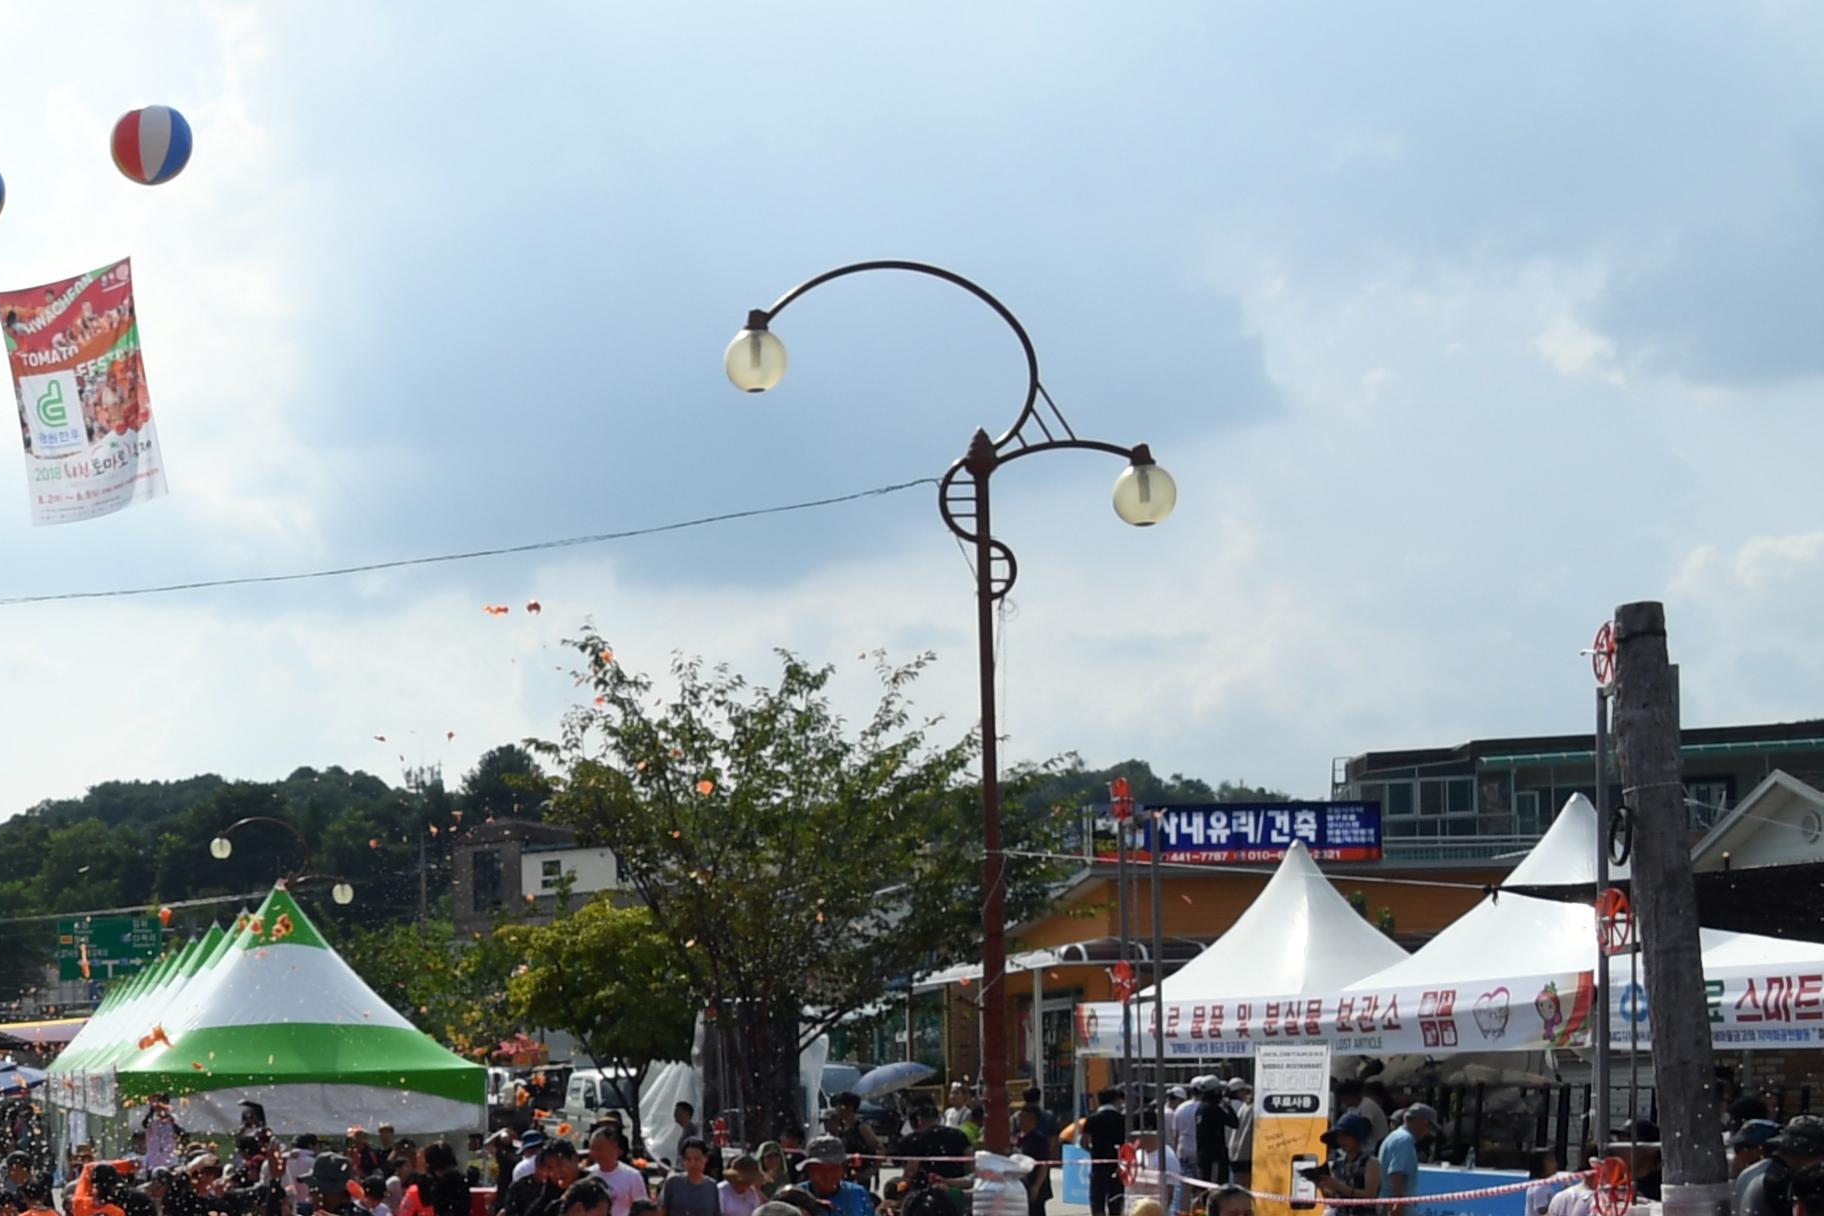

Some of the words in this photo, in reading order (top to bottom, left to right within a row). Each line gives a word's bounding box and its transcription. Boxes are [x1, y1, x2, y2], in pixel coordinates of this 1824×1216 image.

[23, 273, 94, 335] HWACHEON
[20, 344, 79, 367] TOMATO
[34, 466, 62, 482] 2018
[92, 450, 129, 477] 토마토
[1189, 1004, 1225, 1039] 물품
[1235, 1003, 1252, 1039] 및
[1263, 999, 1324, 1037] 분실물
[1336, 993, 1403, 1033] 보관소
[1734, 975, 1824, 1023] 스마트
